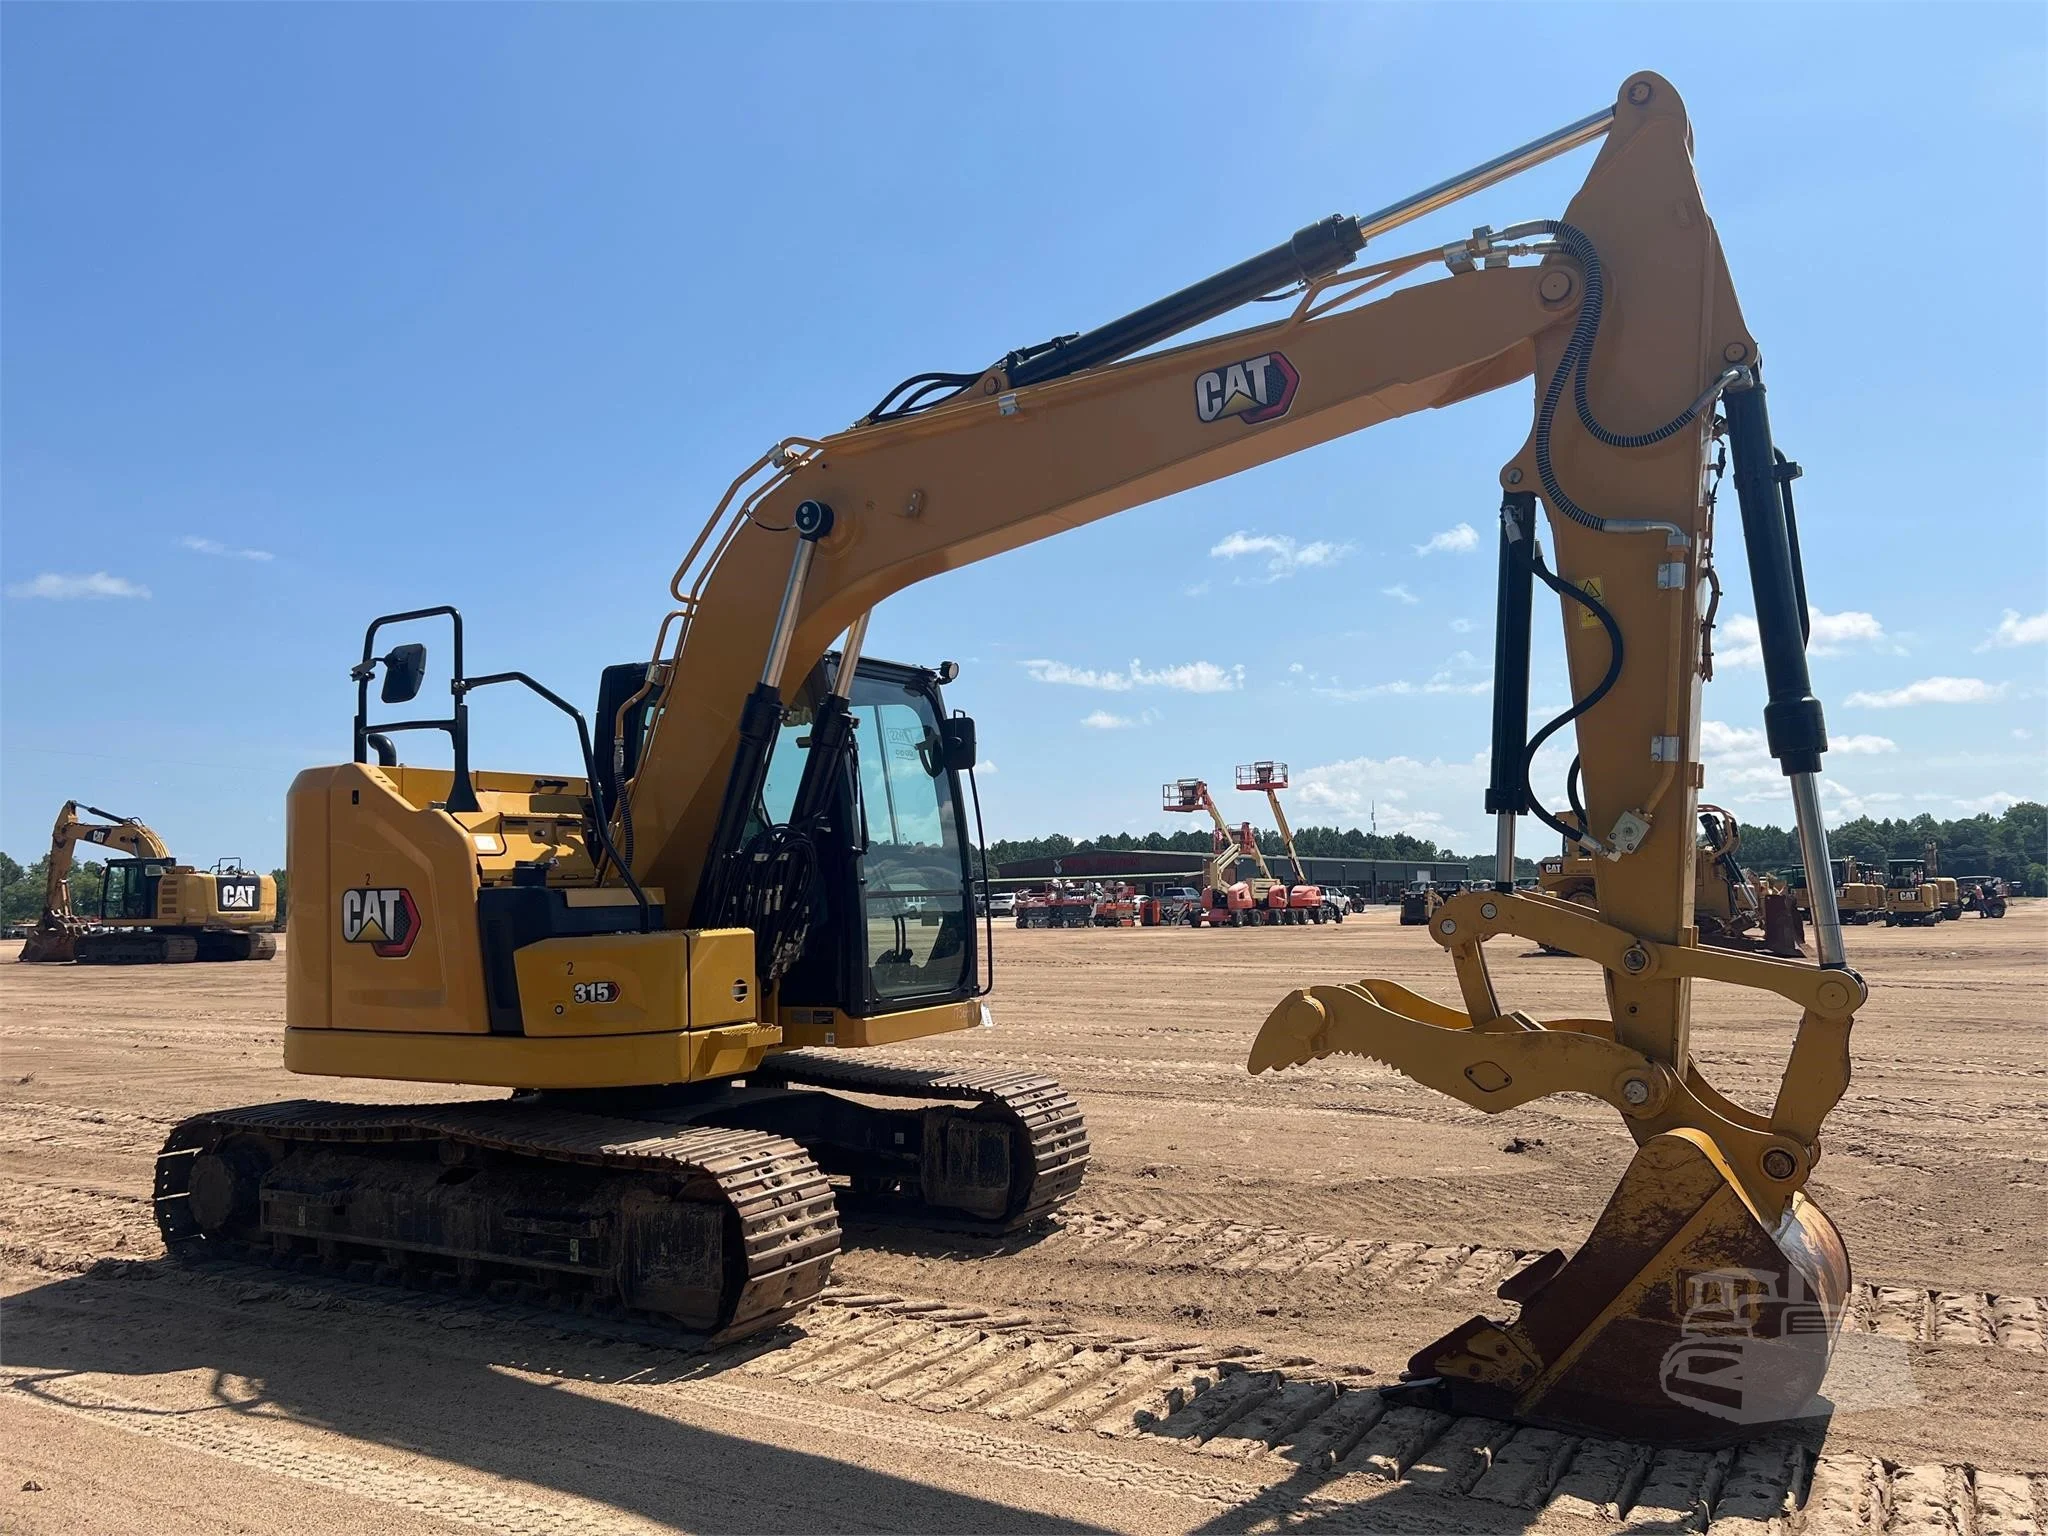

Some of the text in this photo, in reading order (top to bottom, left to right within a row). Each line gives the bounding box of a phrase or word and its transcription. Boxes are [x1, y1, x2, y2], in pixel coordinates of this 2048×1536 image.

[1197, 355, 1271, 421] CAT
[92, 830, 105, 843] CAT
[1545, 864, 1561, 873] CAT
[365, 873, 371, 885] 2
[222, 885, 255, 907] CAT
[1900, 891, 1916, 900] CAT
[343, 890, 400, 941] CAT
[566, 961, 574, 976] 2
[574, 983, 609, 1002] 315
